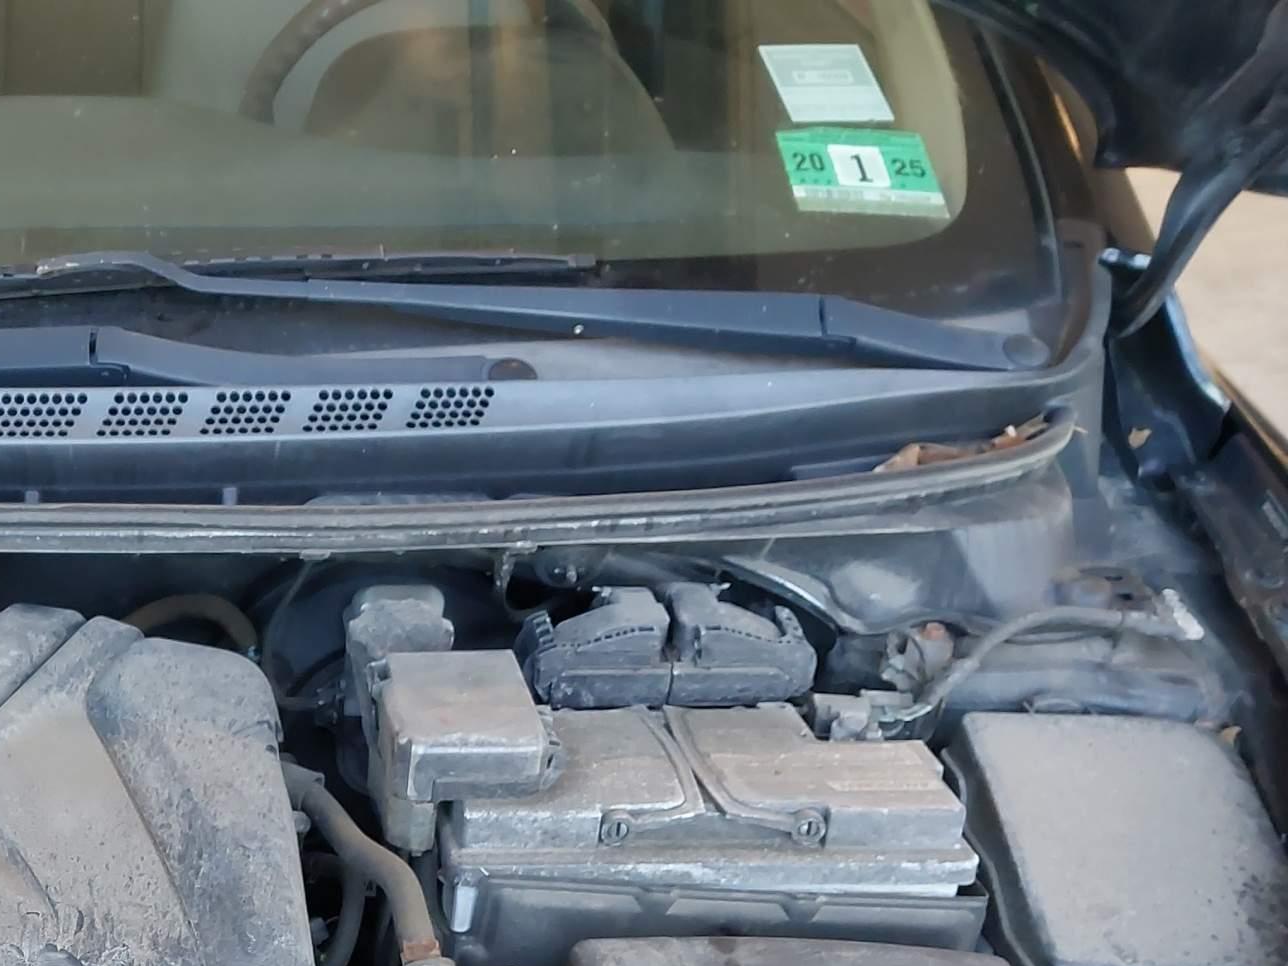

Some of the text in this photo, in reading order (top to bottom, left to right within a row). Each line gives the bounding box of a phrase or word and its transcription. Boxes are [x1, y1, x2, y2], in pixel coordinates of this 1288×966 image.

[792, 152, 926, 183] 20 1 25
